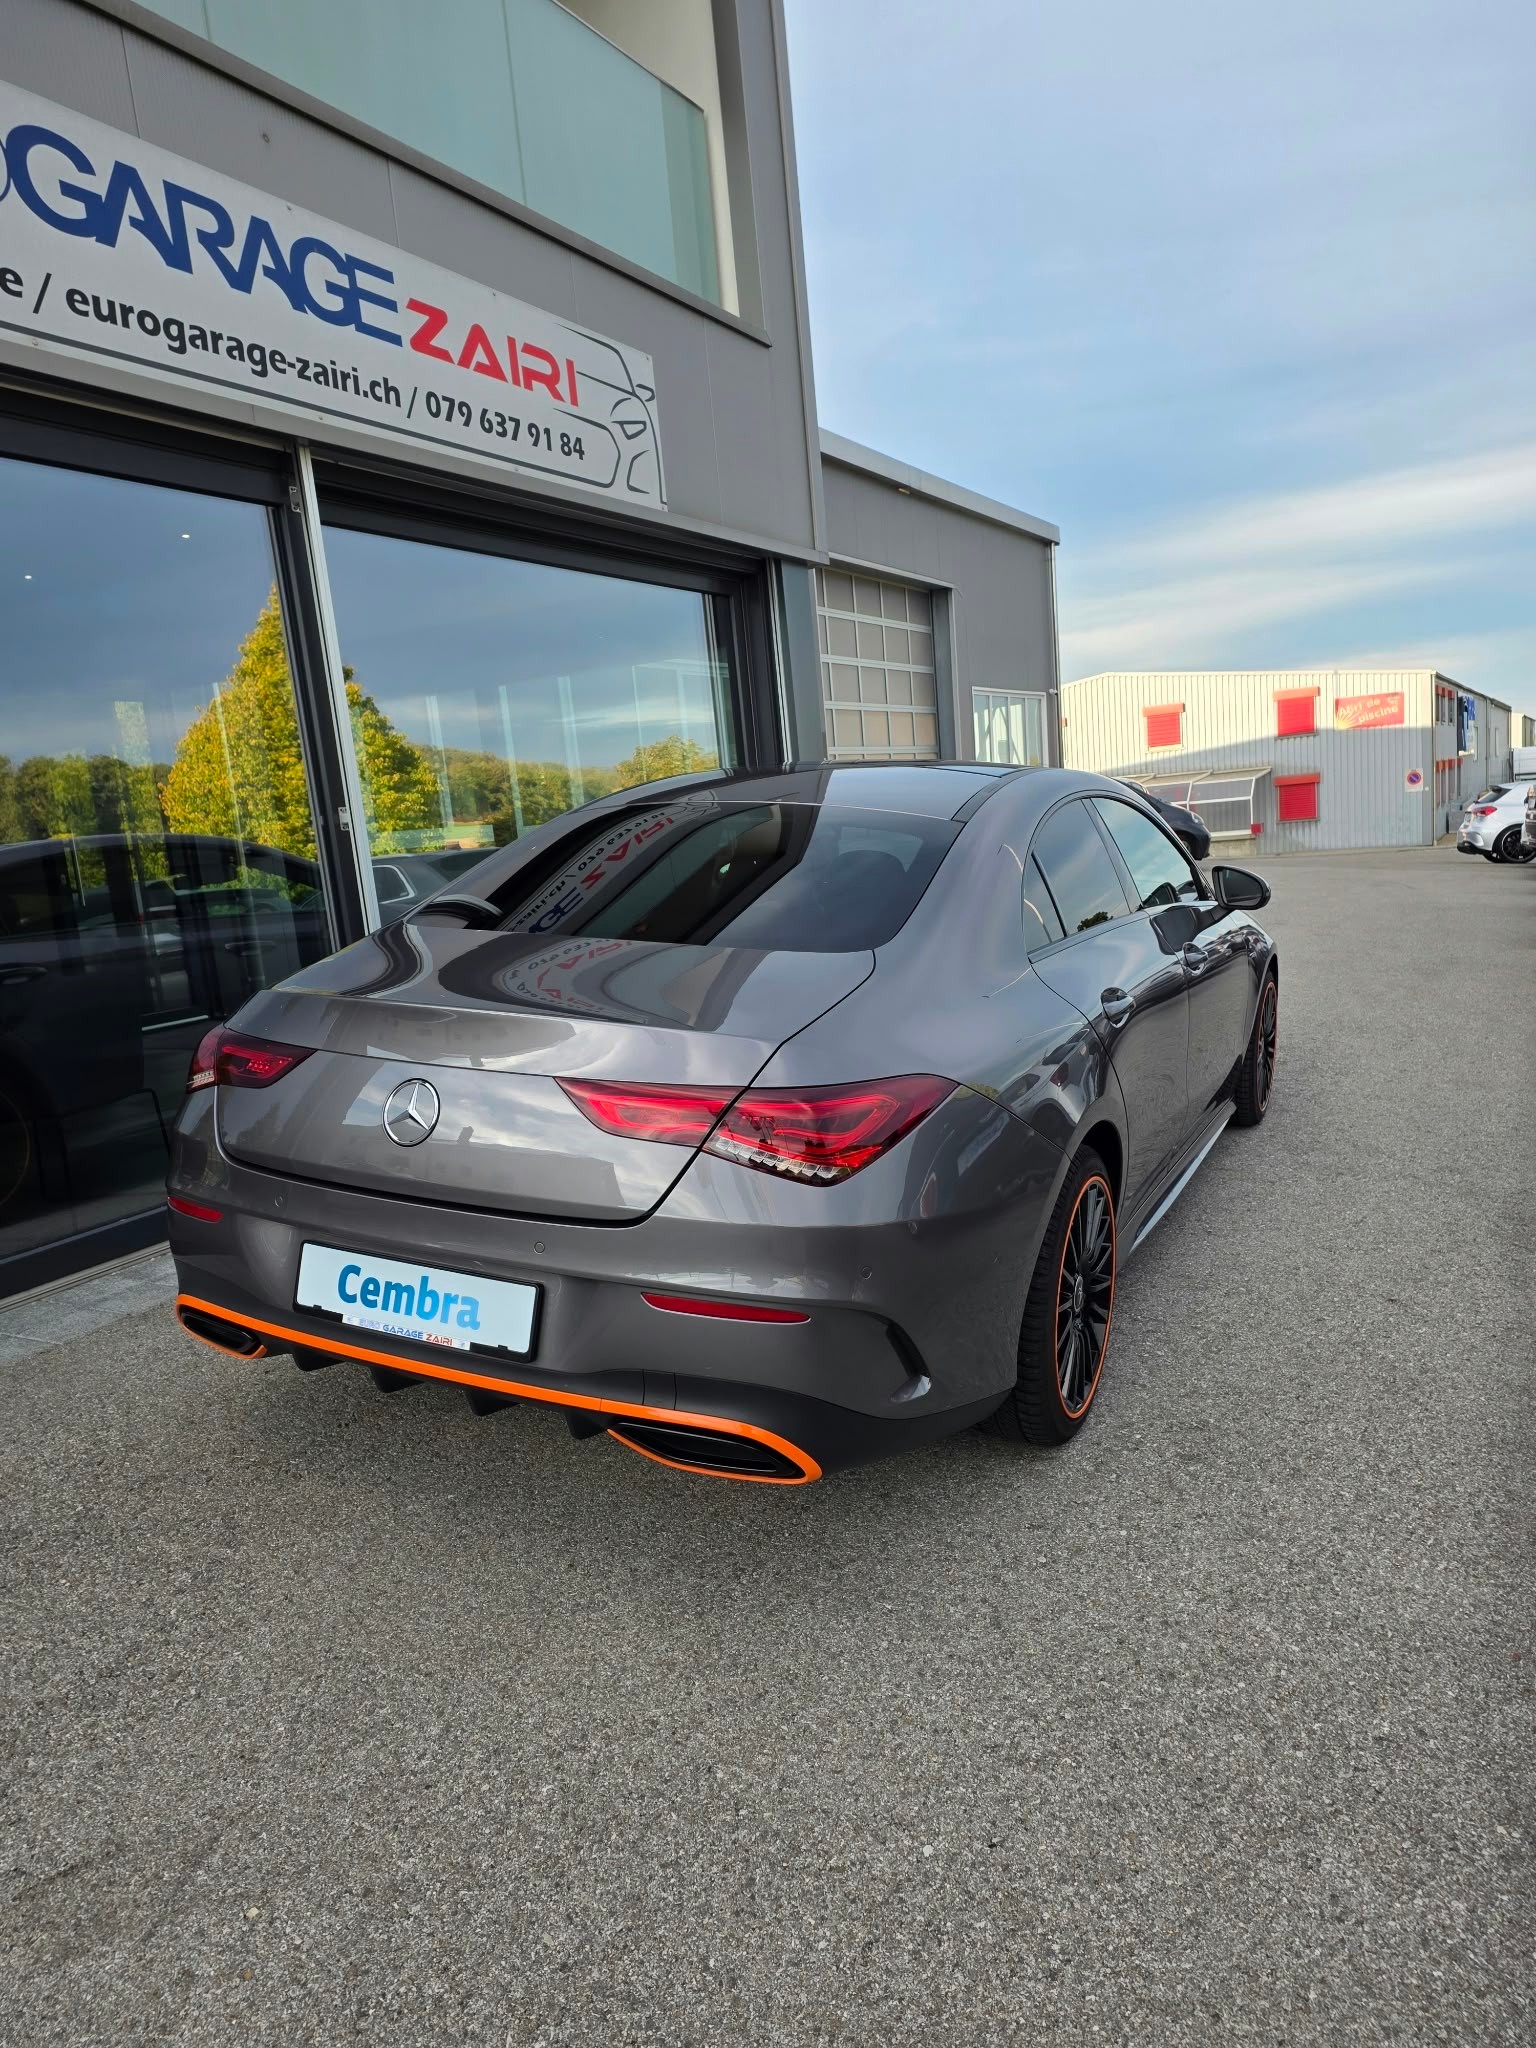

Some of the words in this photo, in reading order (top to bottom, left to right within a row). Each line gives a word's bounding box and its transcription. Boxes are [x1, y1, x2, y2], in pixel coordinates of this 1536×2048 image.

[0, 124, 402, 347] GARAGE
[406, 297, 578, 407] ZAIRI
[65, 288, 401, 408] eurogarage-zairi.ch
[426, 391, 472, 427] 079
[480, 408, 520, 441] 637
[527, 422, 552, 451] 91
[560, 432, 585, 460] 84
[337, 1264, 480, 1330] Cembra
[382, 1324, 424, 1339] GARAGE
[425, 1333, 453, 1346] ZAIRI
